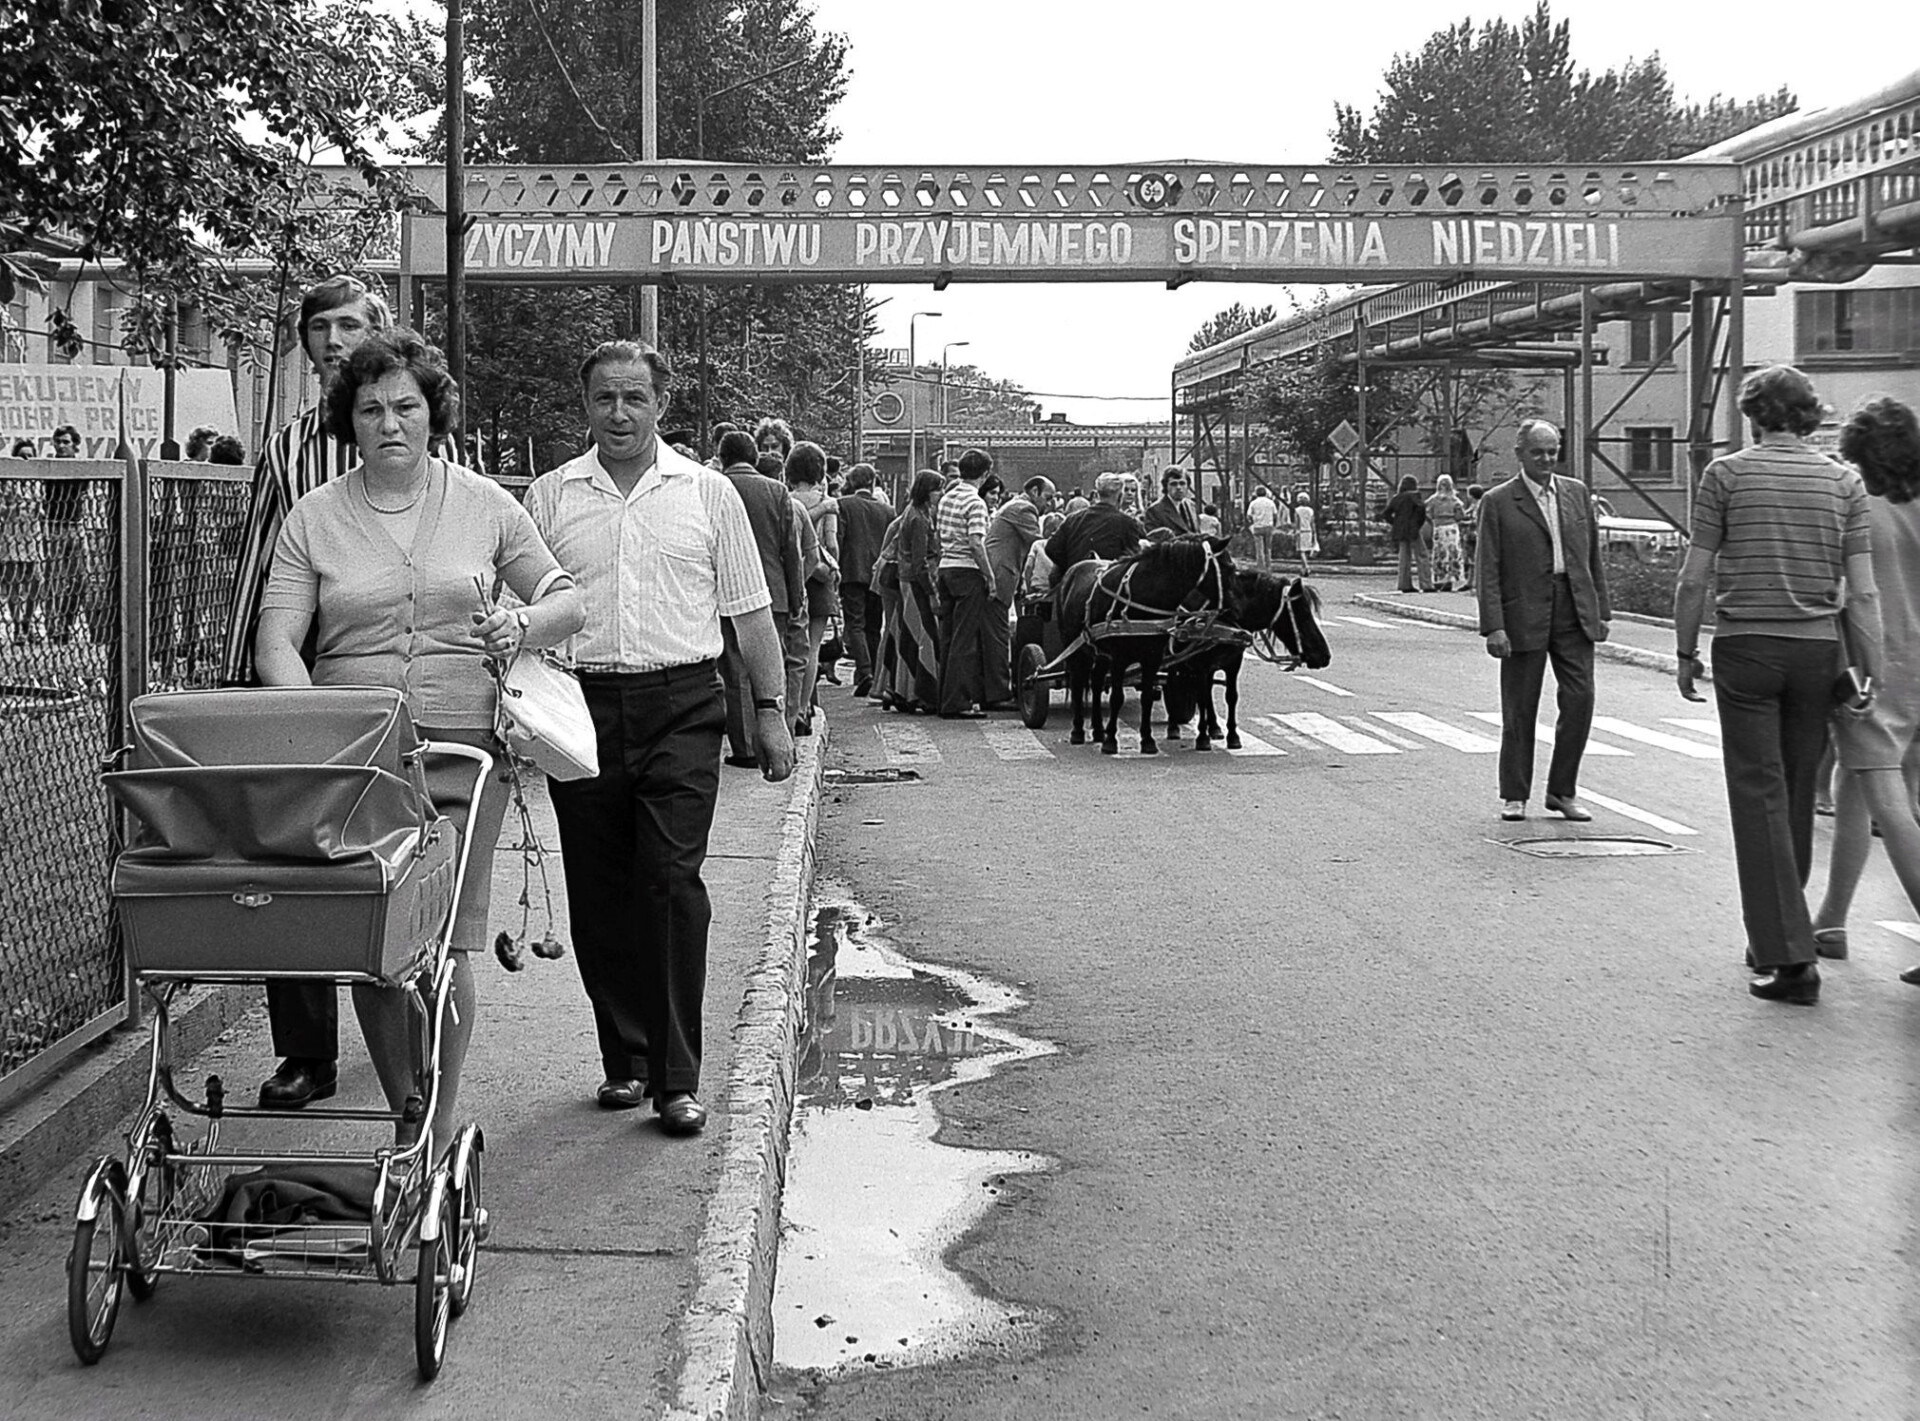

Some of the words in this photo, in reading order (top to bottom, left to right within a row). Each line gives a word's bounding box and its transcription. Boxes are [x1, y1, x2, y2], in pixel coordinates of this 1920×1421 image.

[652, 217, 820, 266] PAŃSTWU
[856, 220, 1132, 266] PRZYJEMNEGO
[1432, 219, 1618, 267] NIEDZIELI
